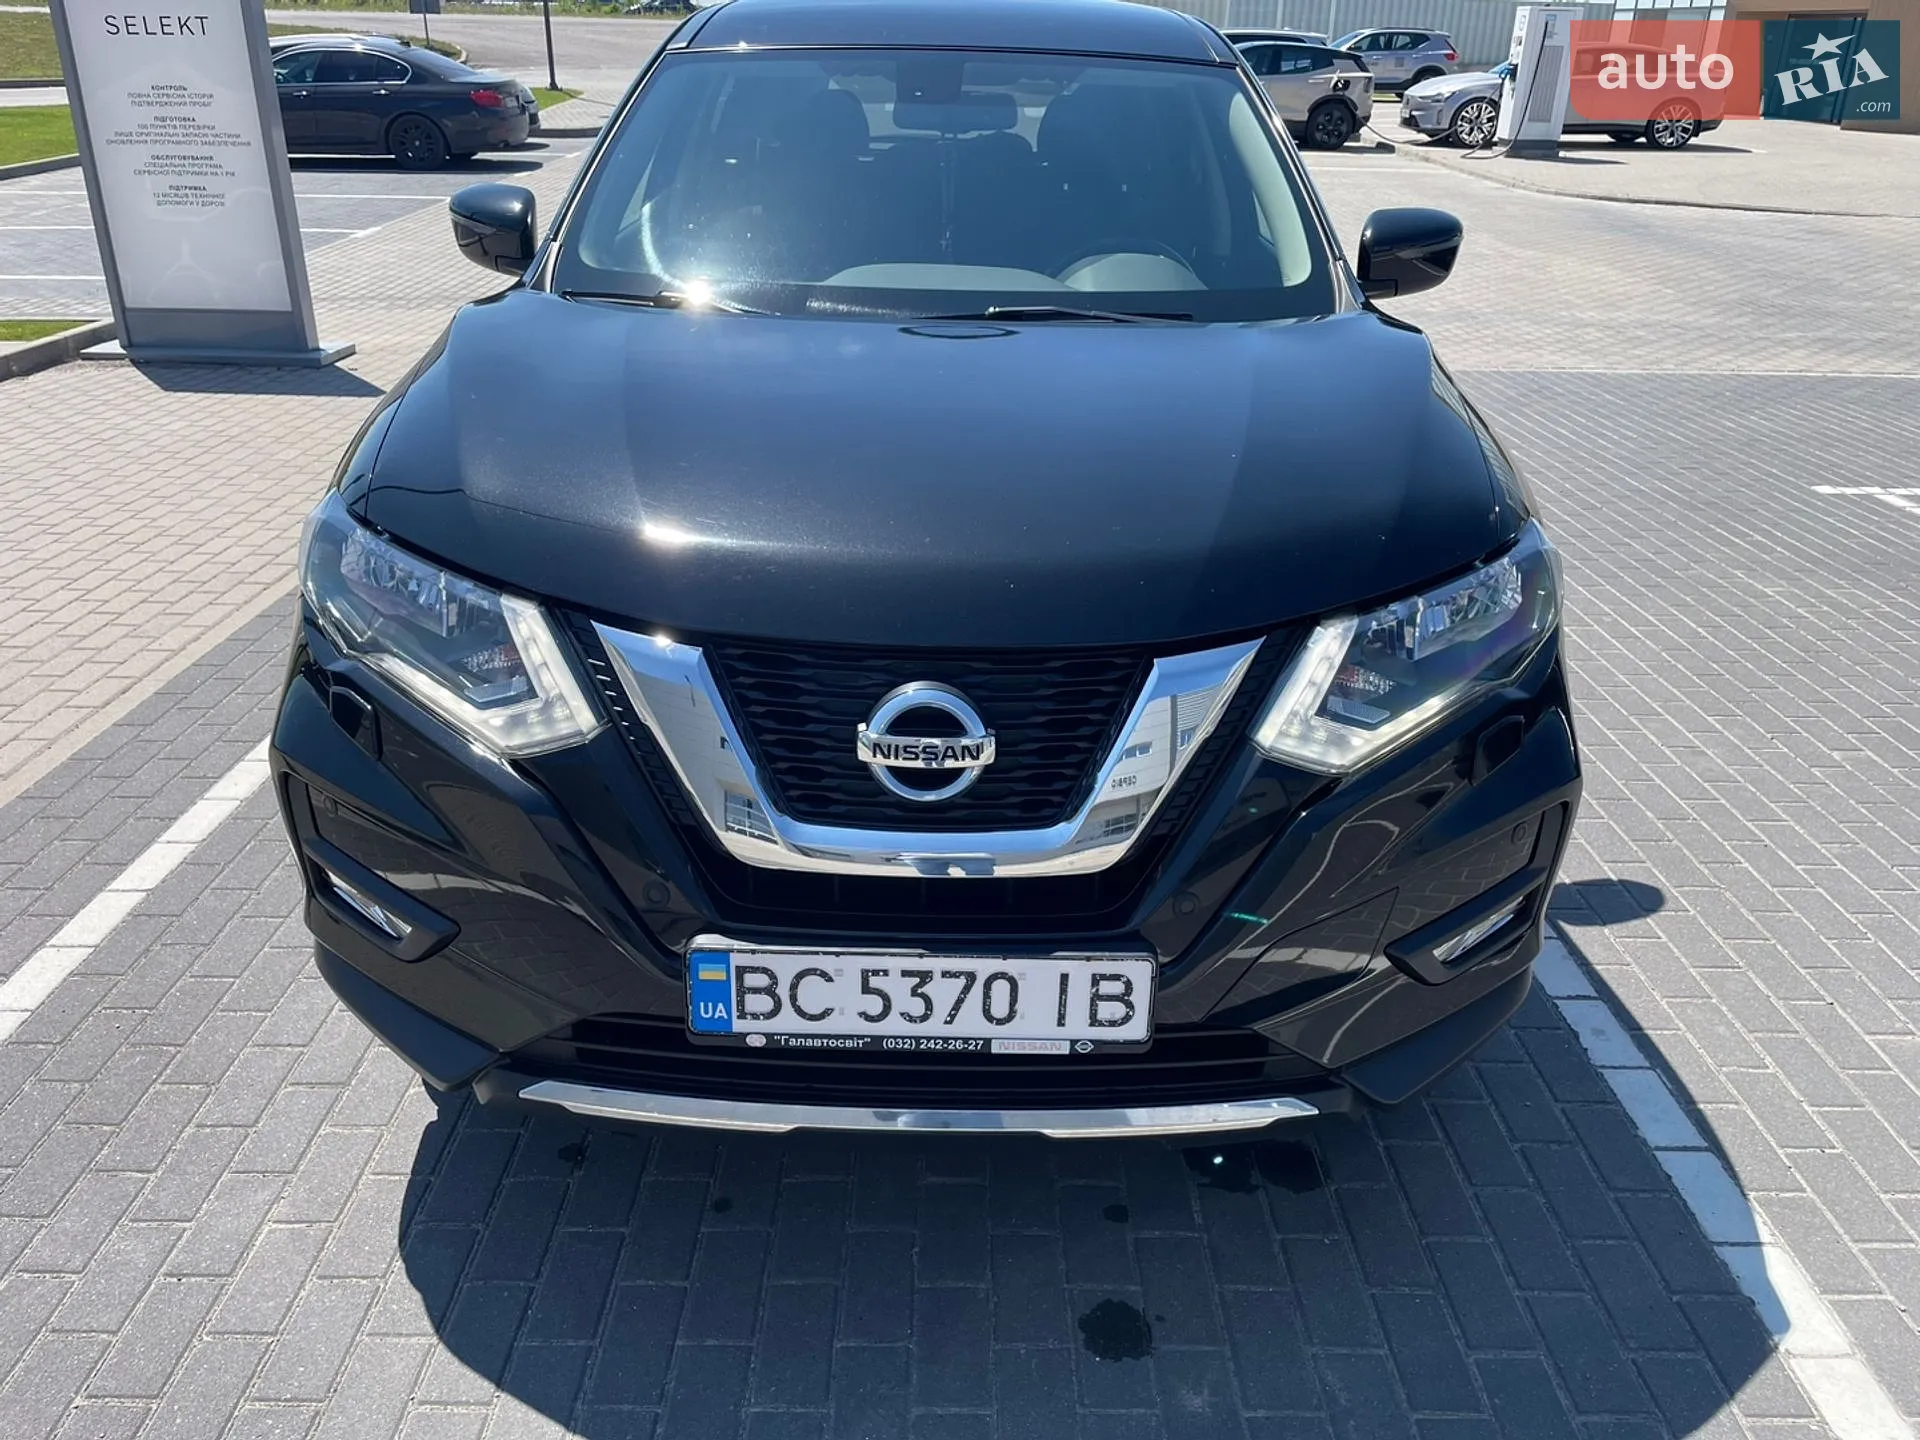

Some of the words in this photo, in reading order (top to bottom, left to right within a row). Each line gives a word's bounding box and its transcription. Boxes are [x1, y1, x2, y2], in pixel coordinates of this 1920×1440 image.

[104, 15, 208, 36] SELEKT
[127, 92, 152, 100] ПОВНА
[151, 84, 188, 92] КОНТРОЛЬ
[872, 742, 980, 762] NISSAN
[735, 965, 834, 1022] BC
[857, 968, 1019, 1026] 5370
[1056, 972, 1135, 1027] IB
[700, 1001, 728, 1019] UA
[774, 1035, 871, 1048] "Галавтосвіт"
[883, 1037, 915, 1050] (032)
[920, 1039, 983, 1050] 242-26-27
[999, 1042, 1062, 1052] NISSAN
